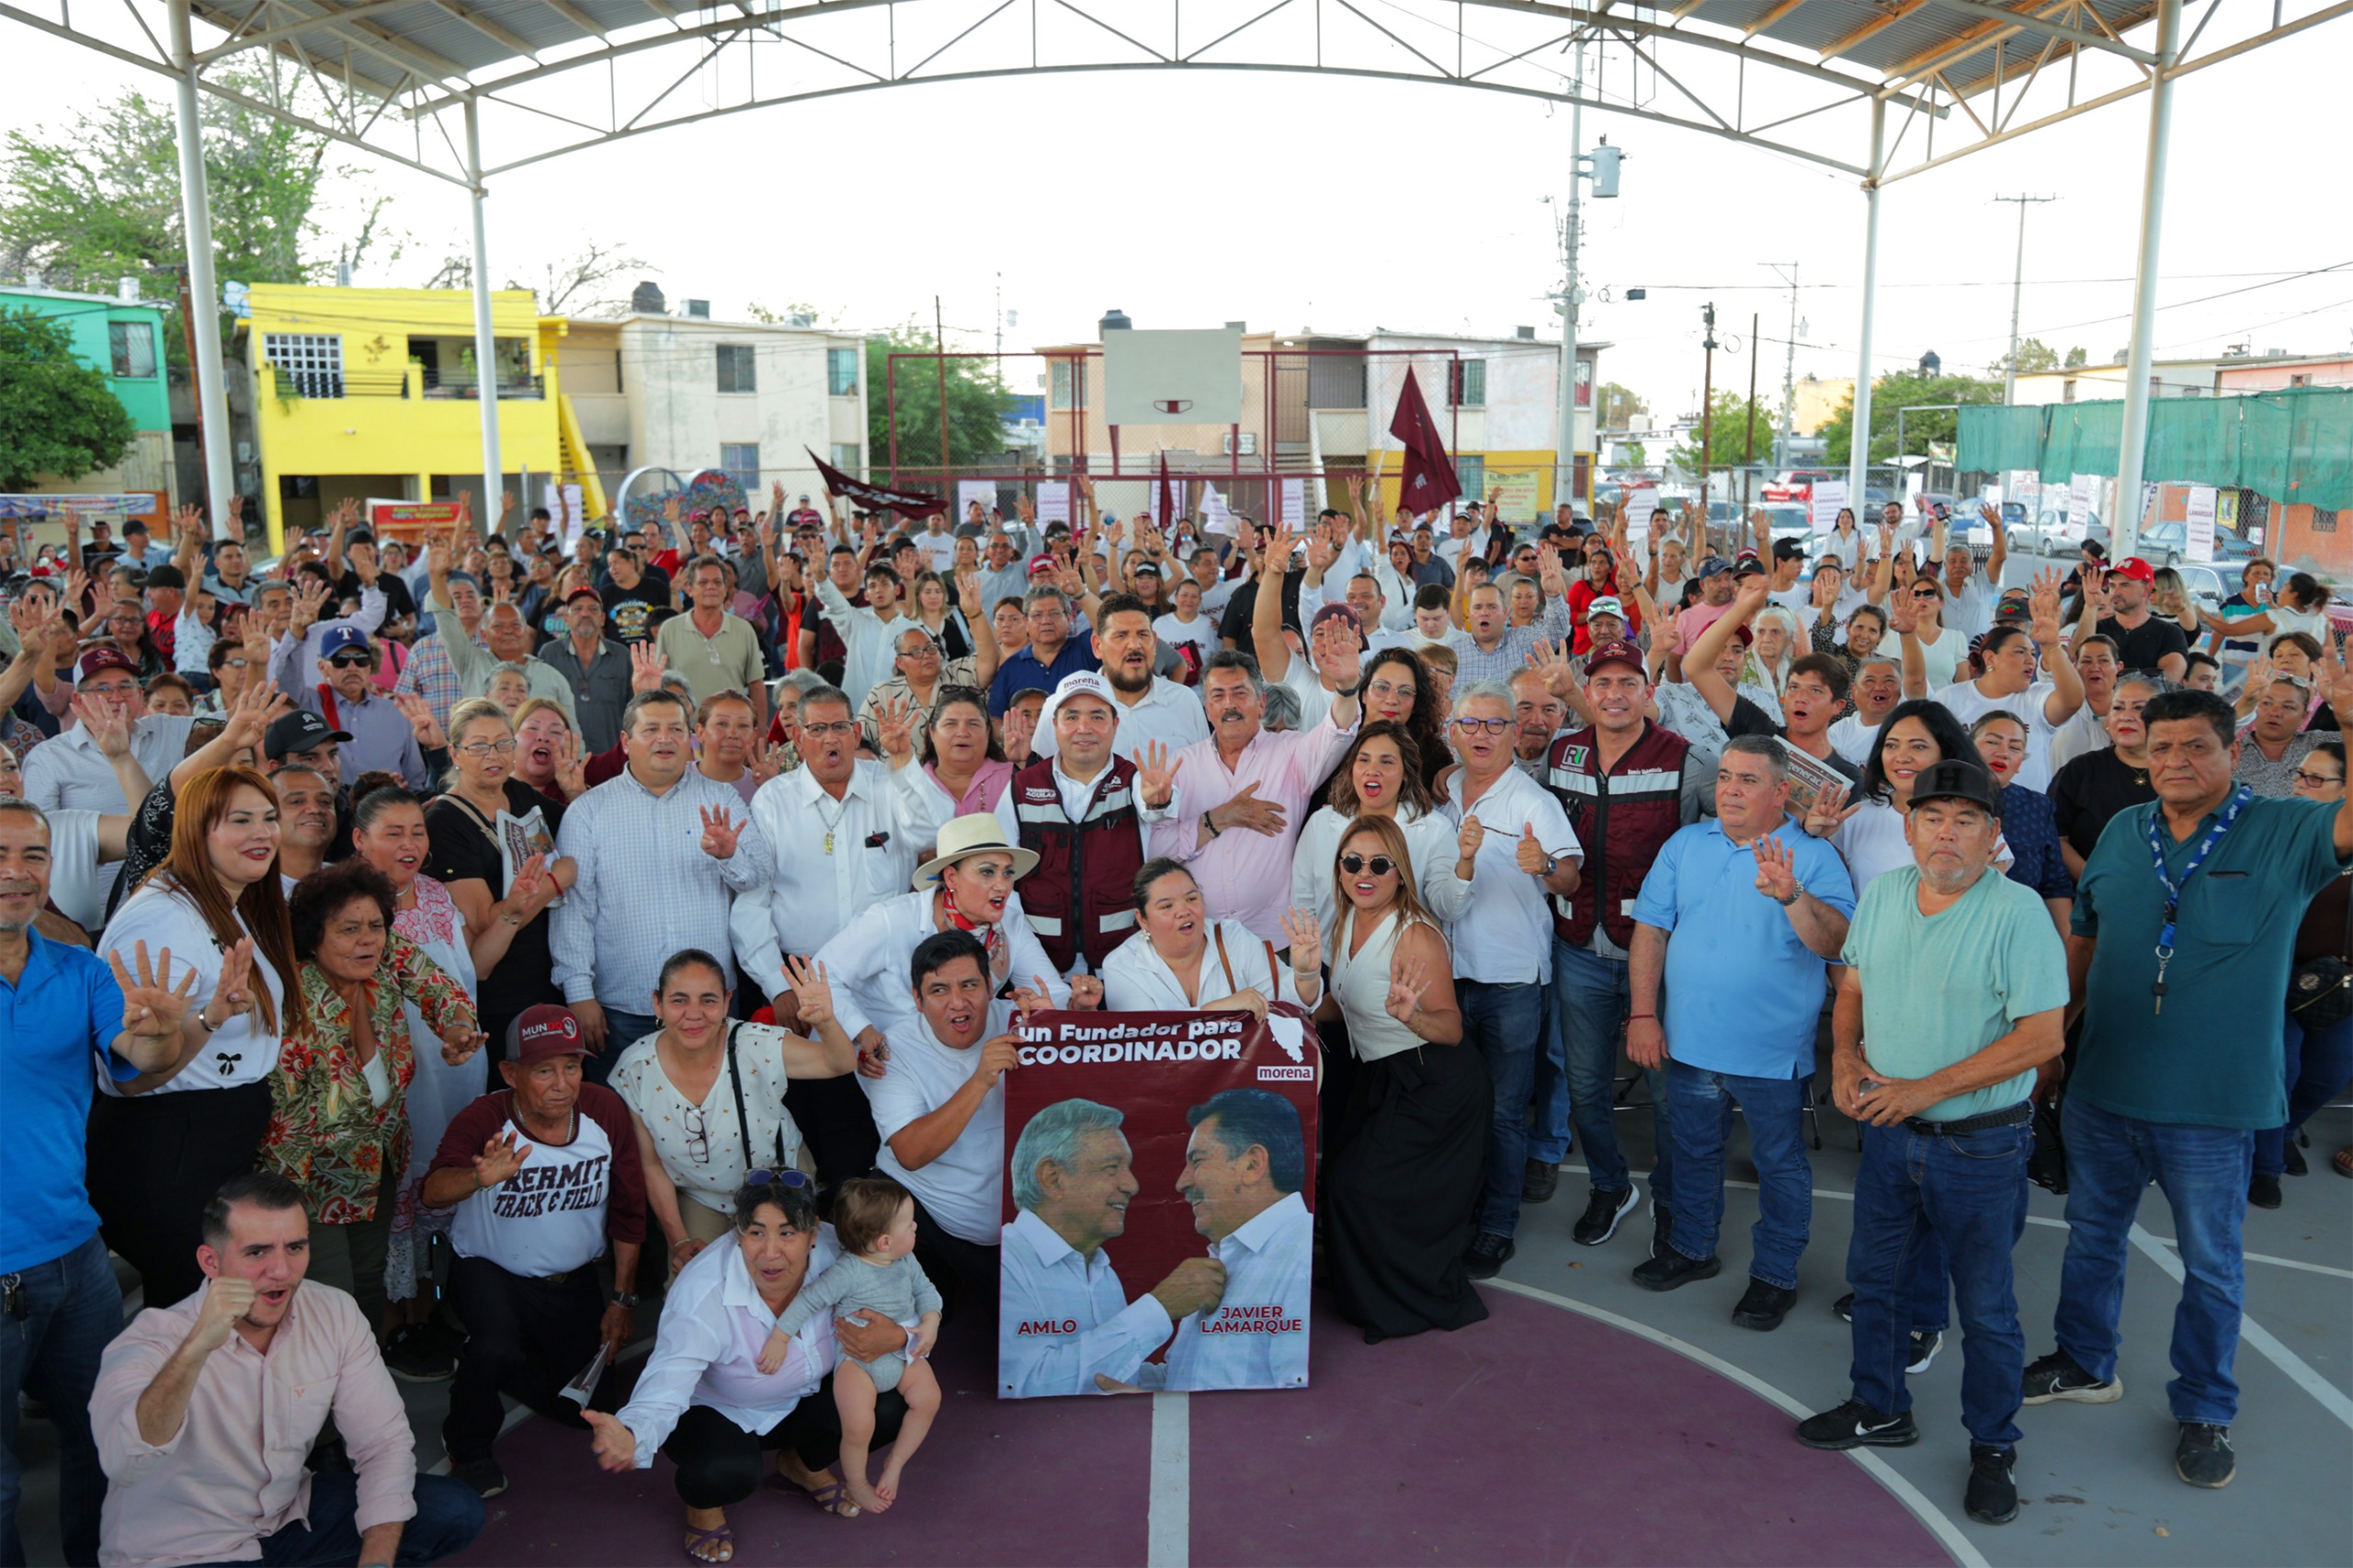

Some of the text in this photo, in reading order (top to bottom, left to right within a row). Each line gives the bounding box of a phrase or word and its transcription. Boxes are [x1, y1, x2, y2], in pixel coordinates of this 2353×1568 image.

[336, 627, 354, 641] T
[1063, 676, 1100, 689] morena
[522, 1021, 563, 1037] MUNDO
[1018, 1021, 1243, 1042] un Fundador para
[1017, 1039, 1241, 1065] COORDINADOR
[1259, 1068, 1311, 1078] morena
[505, 1154, 608, 1193] KERMIT
[495, 1191, 549, 1218] TRACK
[560, 1181, 603, 1211] FIELD
[1221, 1306, 1283, 1319] JAVIER
[1017, 1319, 1078, 1335] AMLO
[1201, 1319, 1302, 1335] LAMARQUE
